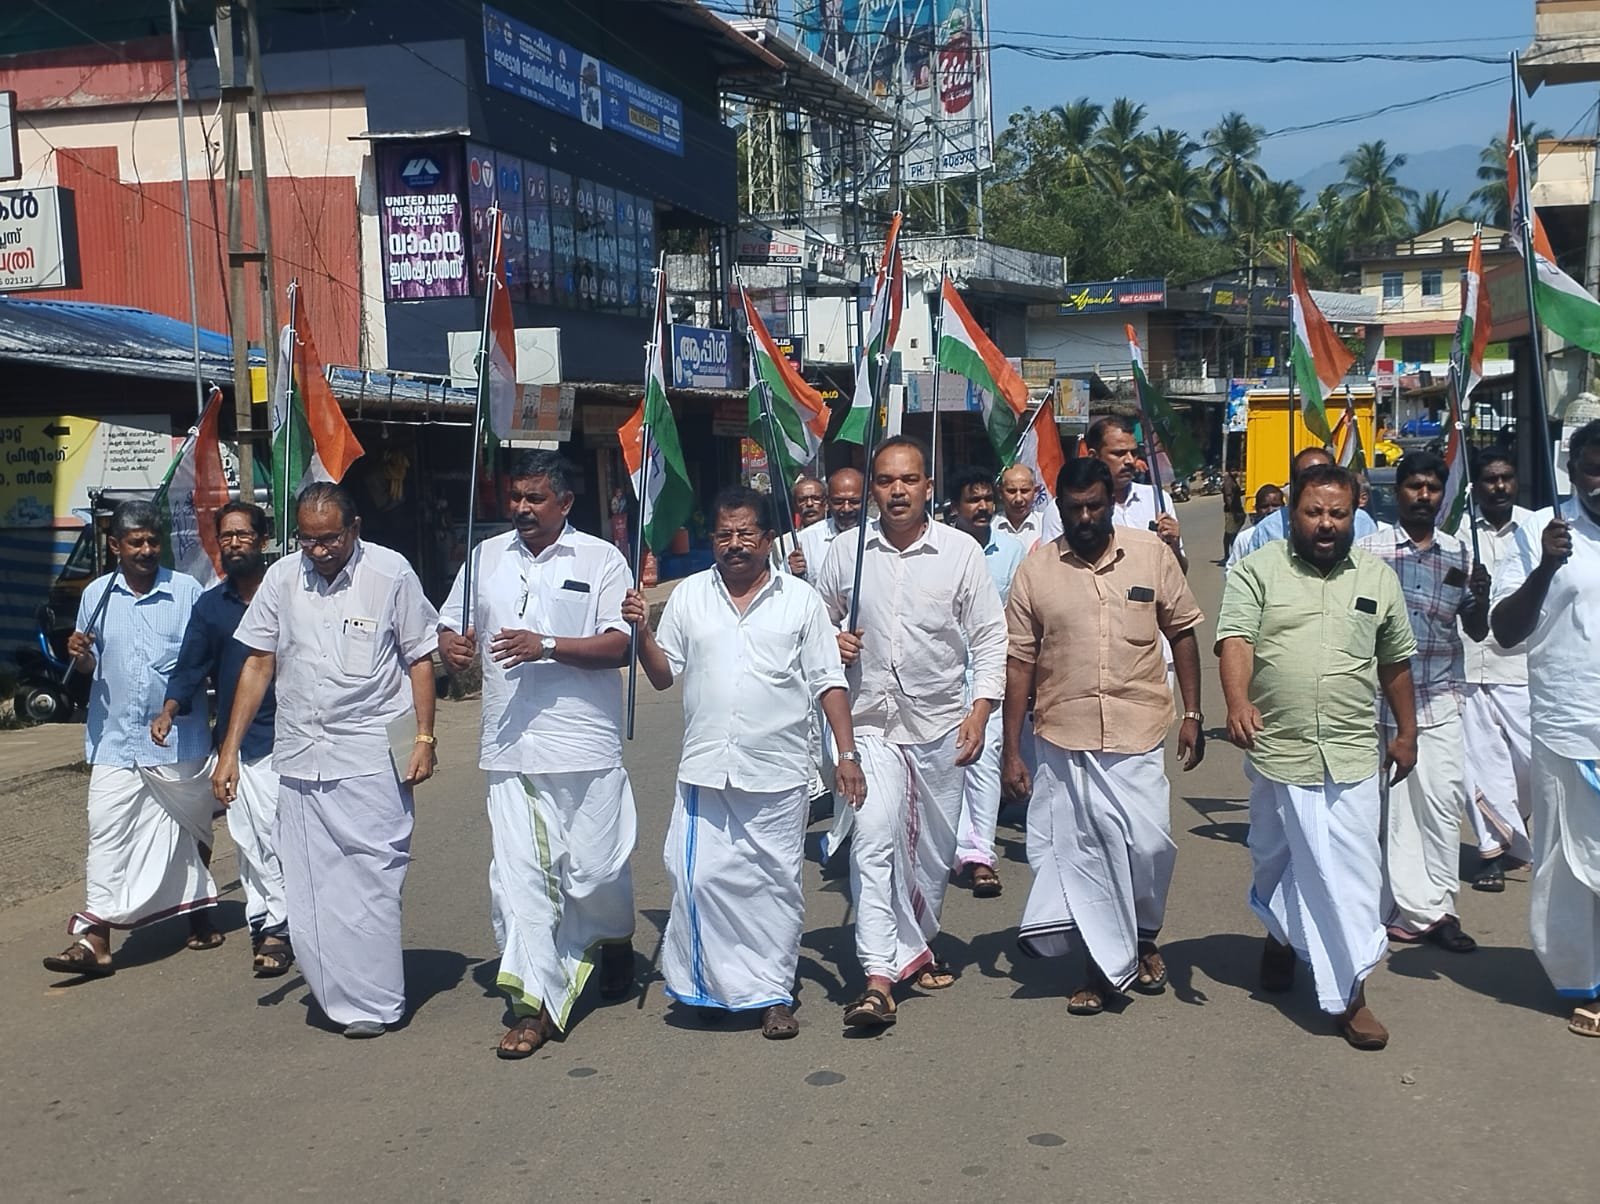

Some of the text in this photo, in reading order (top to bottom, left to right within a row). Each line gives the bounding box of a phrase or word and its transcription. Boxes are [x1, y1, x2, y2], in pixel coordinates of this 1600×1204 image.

[386, 194, 457, 207] UNITED INDIA
[392, 204, 454, 216] INSURANCE
[422, 216, 445, 226] LTD.
[388, 231, 461, 256] വാഹന
[743, 243, 799, 255] EYE PLUS
[5, 276, 34, 285] 021321
[1134, 292, 1163, 303] GALLERY
[6, 446, 68, 465] പ്രിന്റിംഗ്
[16, 469, 53, 485] സീൽ
